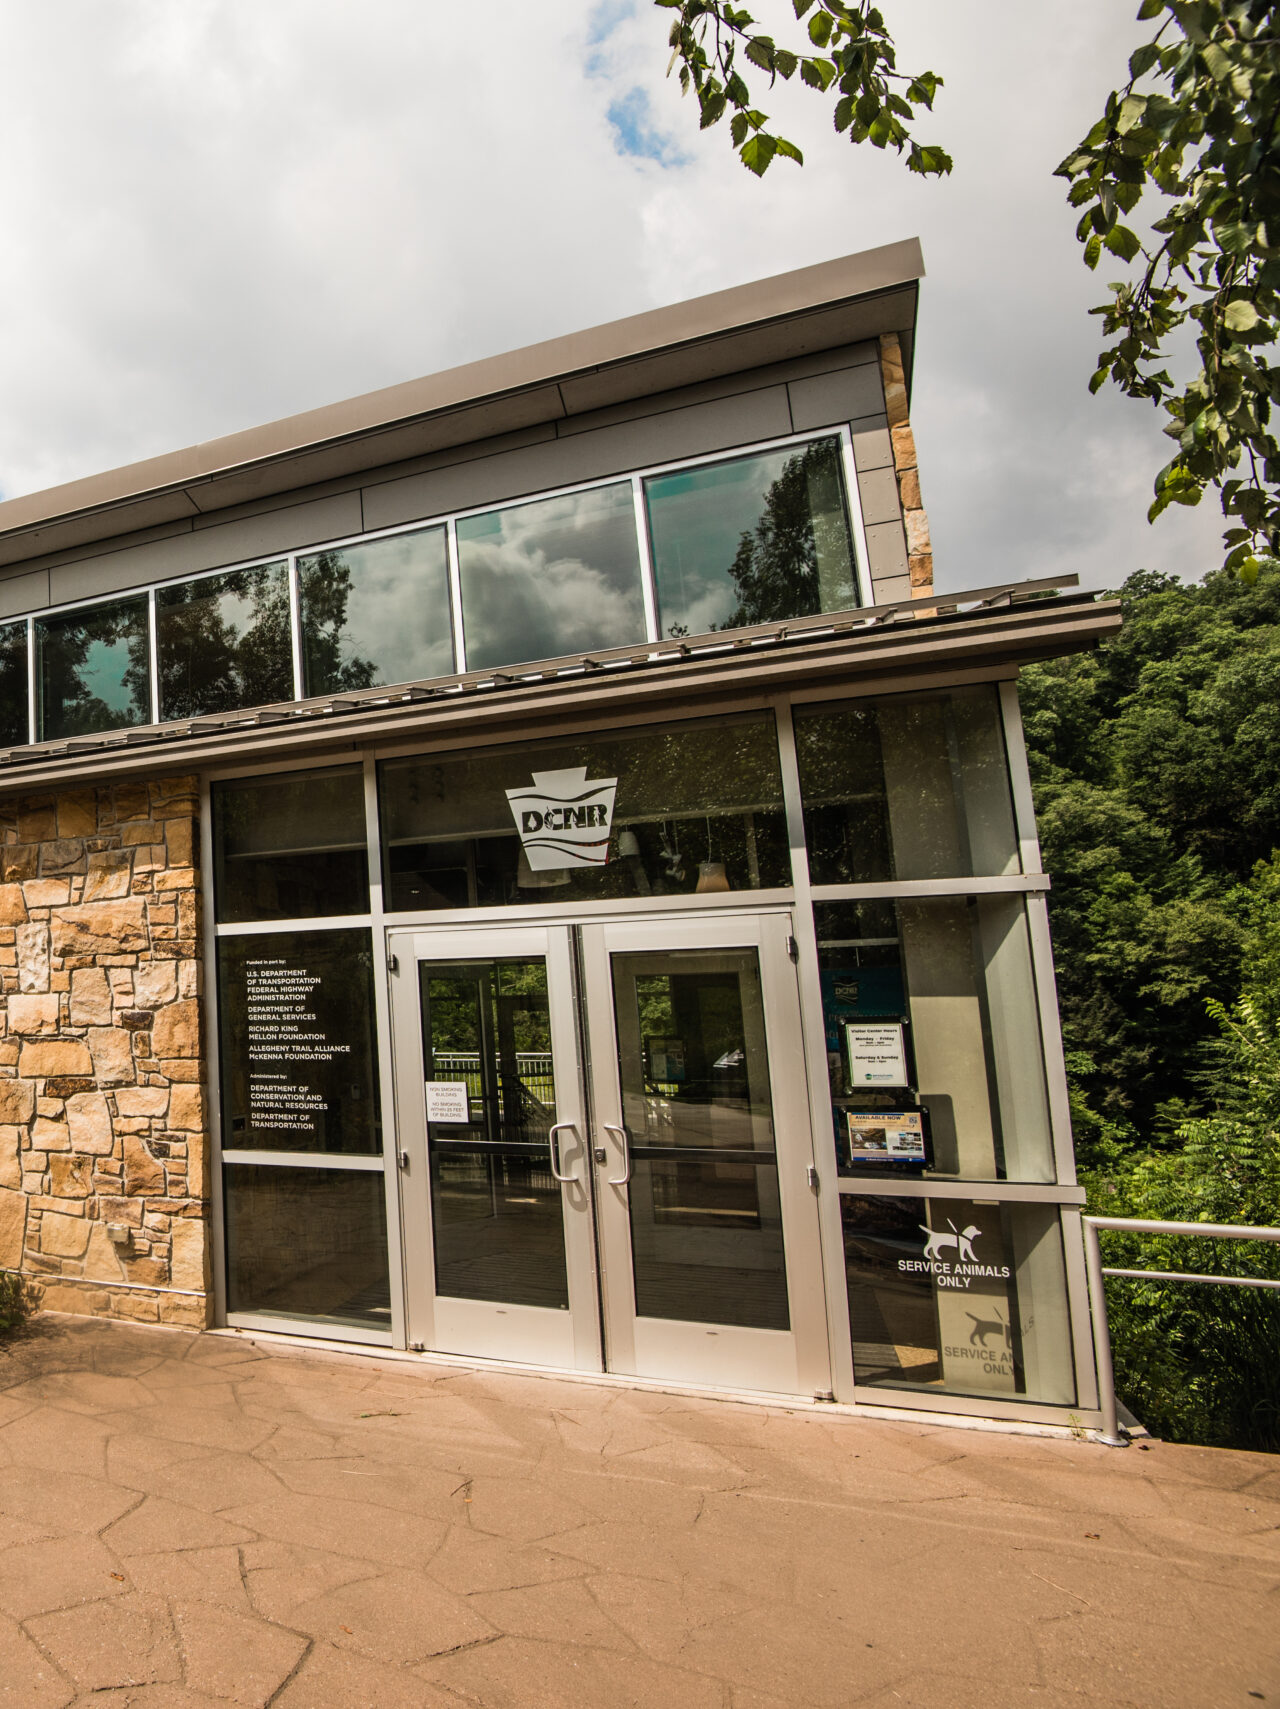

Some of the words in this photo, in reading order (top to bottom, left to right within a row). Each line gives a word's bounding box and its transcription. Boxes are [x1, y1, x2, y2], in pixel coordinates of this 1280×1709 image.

[521, 803, 608, 834] DCNR
[260, 969, 307, 977] DEPARTMENT
[258, 977, 321, 985] TRANSPORTATION
[280, 985, 314, 993] HIGHWAY
[250, 1093, 304, 1101] CONSERVATION
[285, 1102, 328, 1110] RESOURCES
[251, 1121, 314, 1130] TRANSPORTATION
[898, 1259, 951, 1274] SERVICE
[954, 1264, 1010, 1278] ANIMALS
[937, 1275, 971, 1288] ONLY
[944, 1346, 996, 1361] SERVICE
